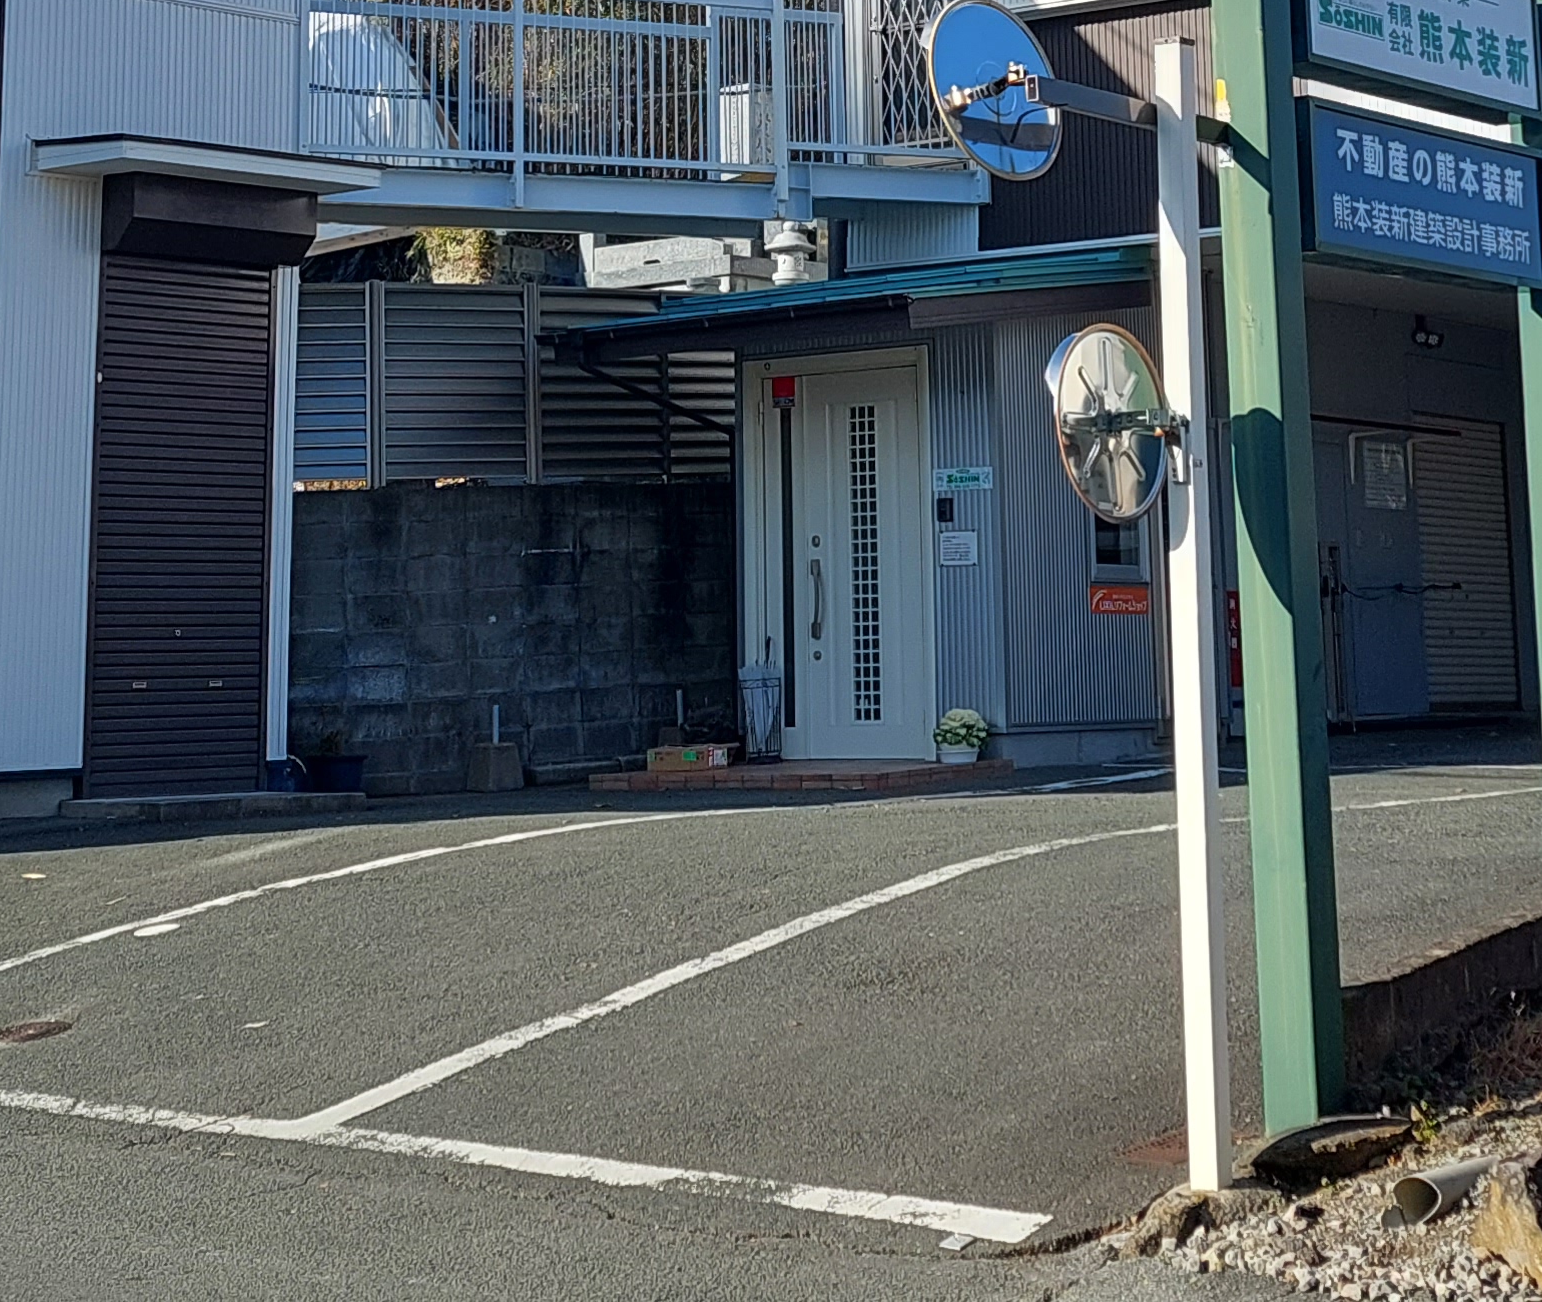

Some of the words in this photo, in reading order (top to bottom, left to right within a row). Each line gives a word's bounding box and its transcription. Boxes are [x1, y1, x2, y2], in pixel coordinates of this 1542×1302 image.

[1386, 0, 1413, 29] 有限
[1388, 29, 1415, 57] 会社
[1416, 7, 1531, 88] 熊本装新
[1336, 127, 1525, 209] 不動産の熊本装新
[1332, 192, 1532, 265] 熊本装新建築設計事務所
